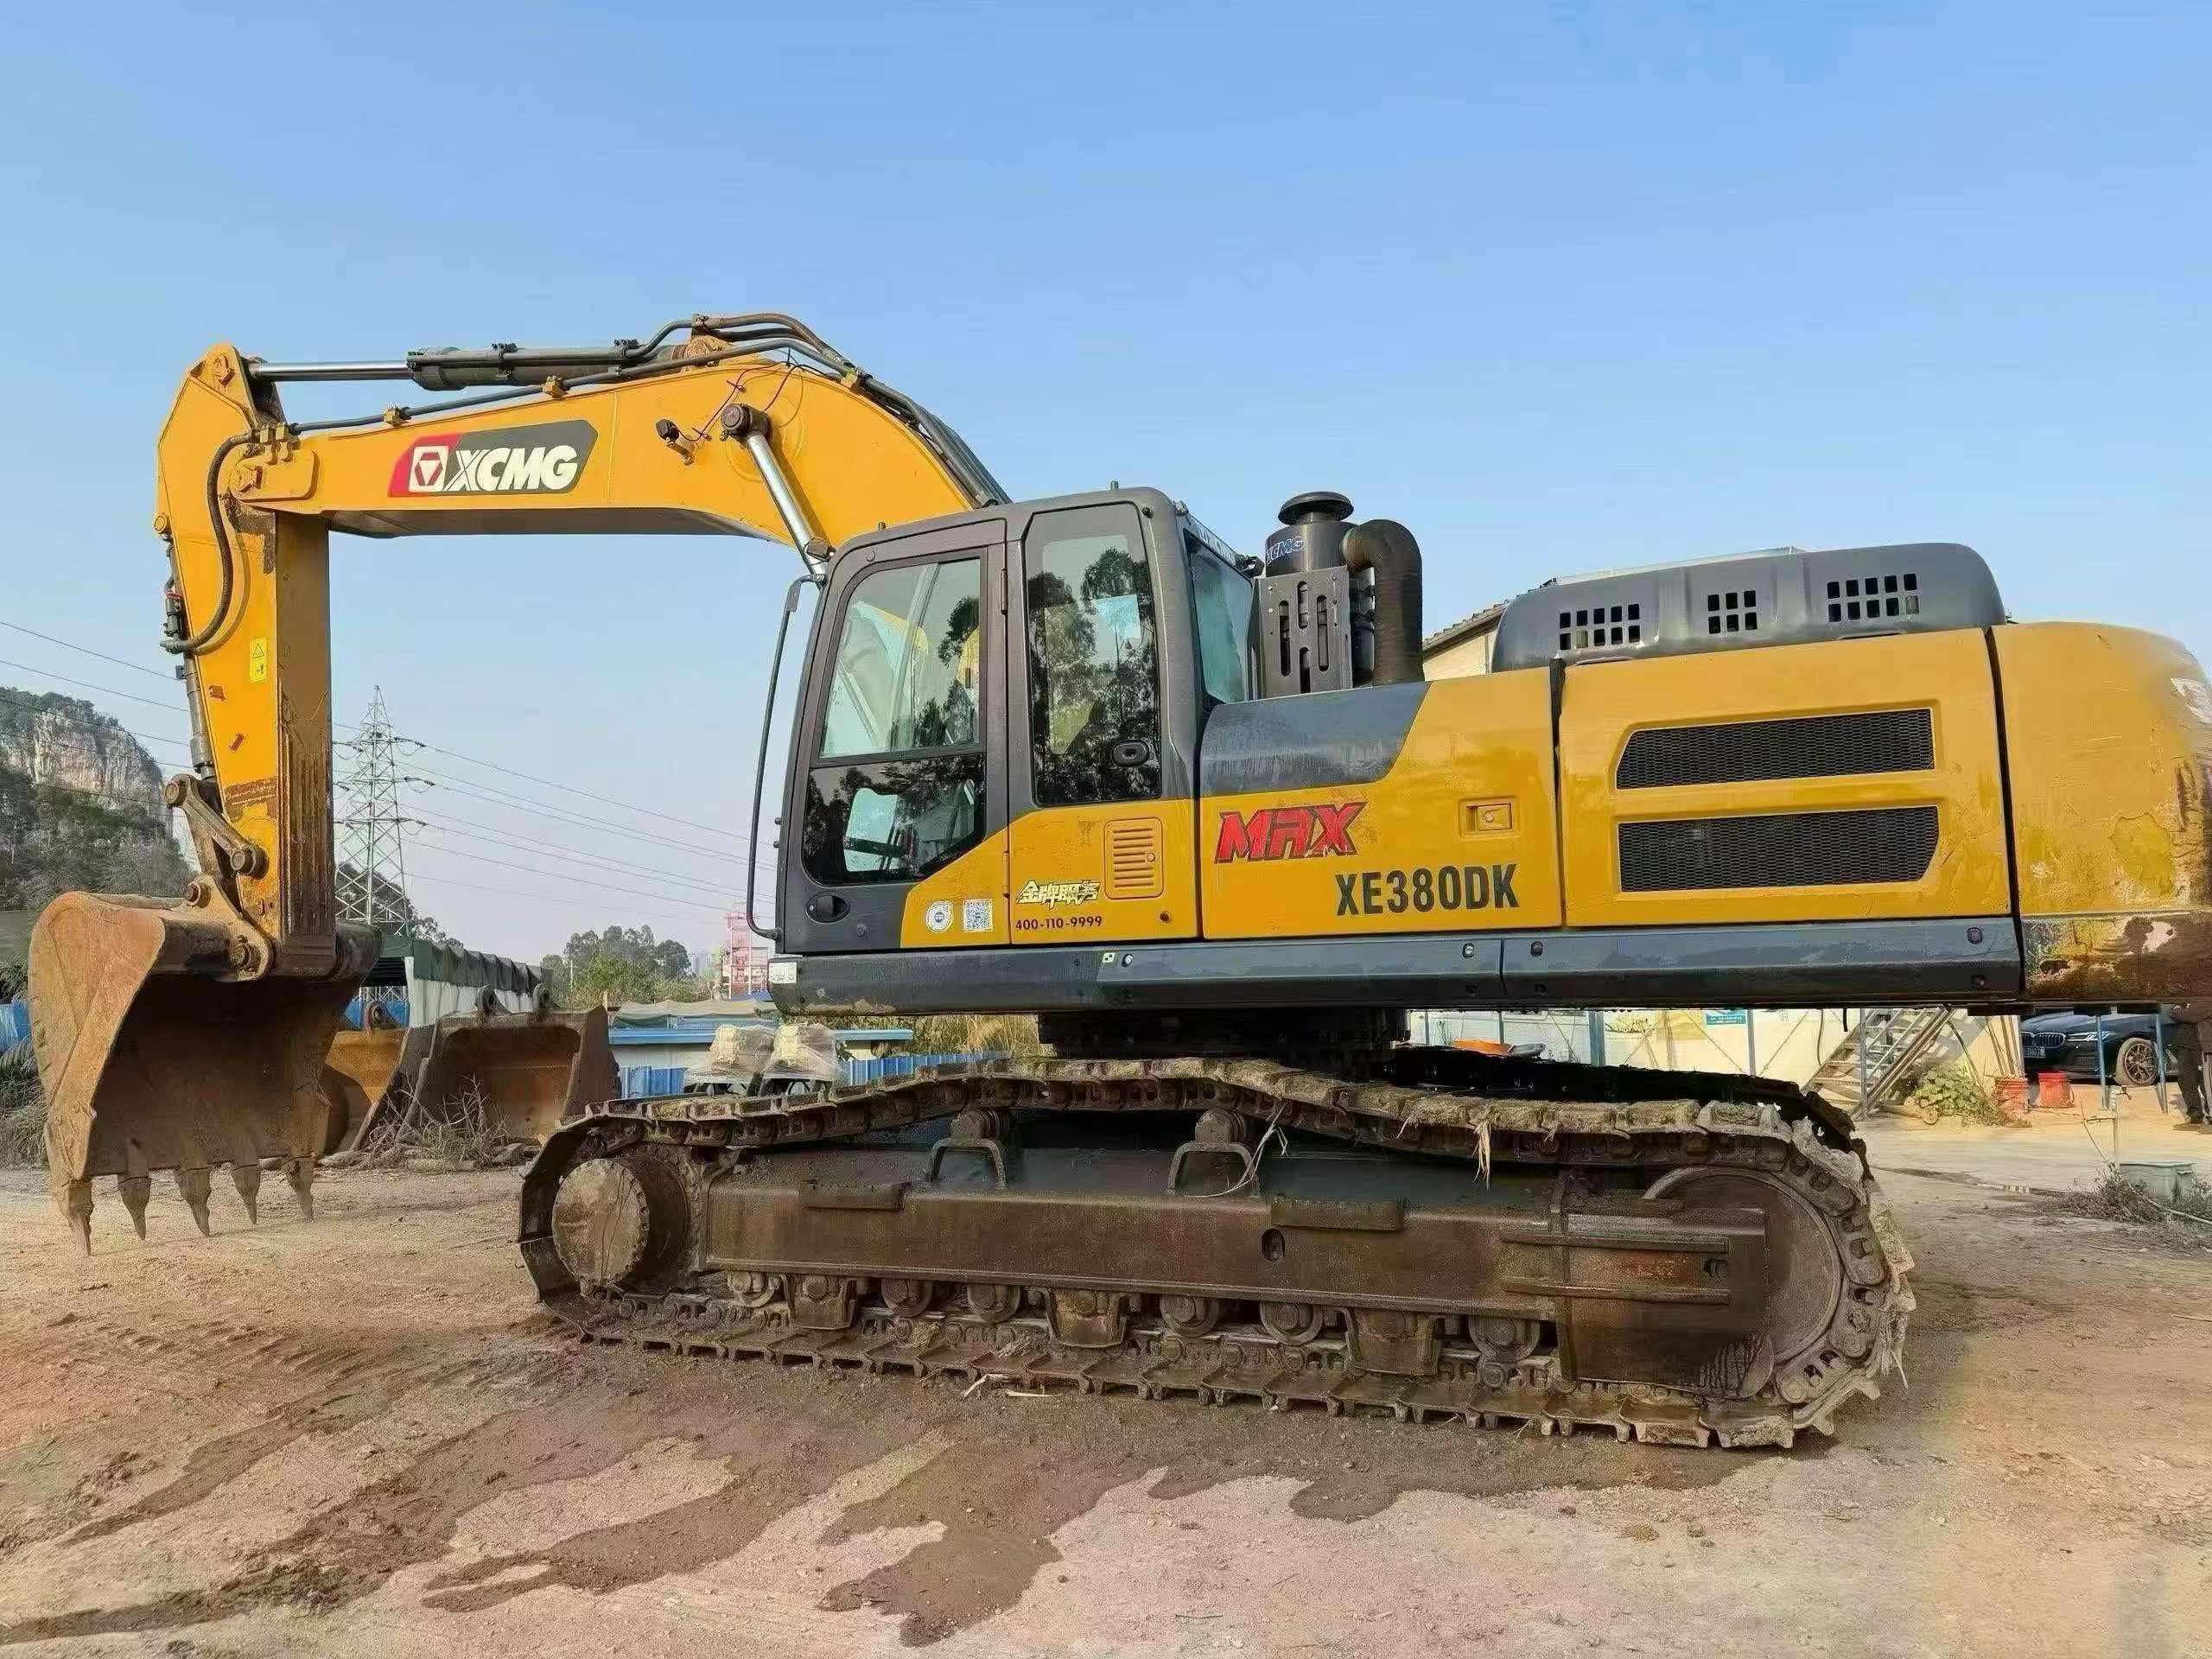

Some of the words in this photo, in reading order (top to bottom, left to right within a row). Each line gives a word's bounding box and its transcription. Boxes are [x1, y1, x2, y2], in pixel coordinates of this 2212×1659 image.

[442, 444, 578, 492] XCMG
[1214, 802, 1368, 863] MAX
[1335, 864, 1520, 917] XE380DK
[1015, 915, 1103, 931] 400-110-9999
